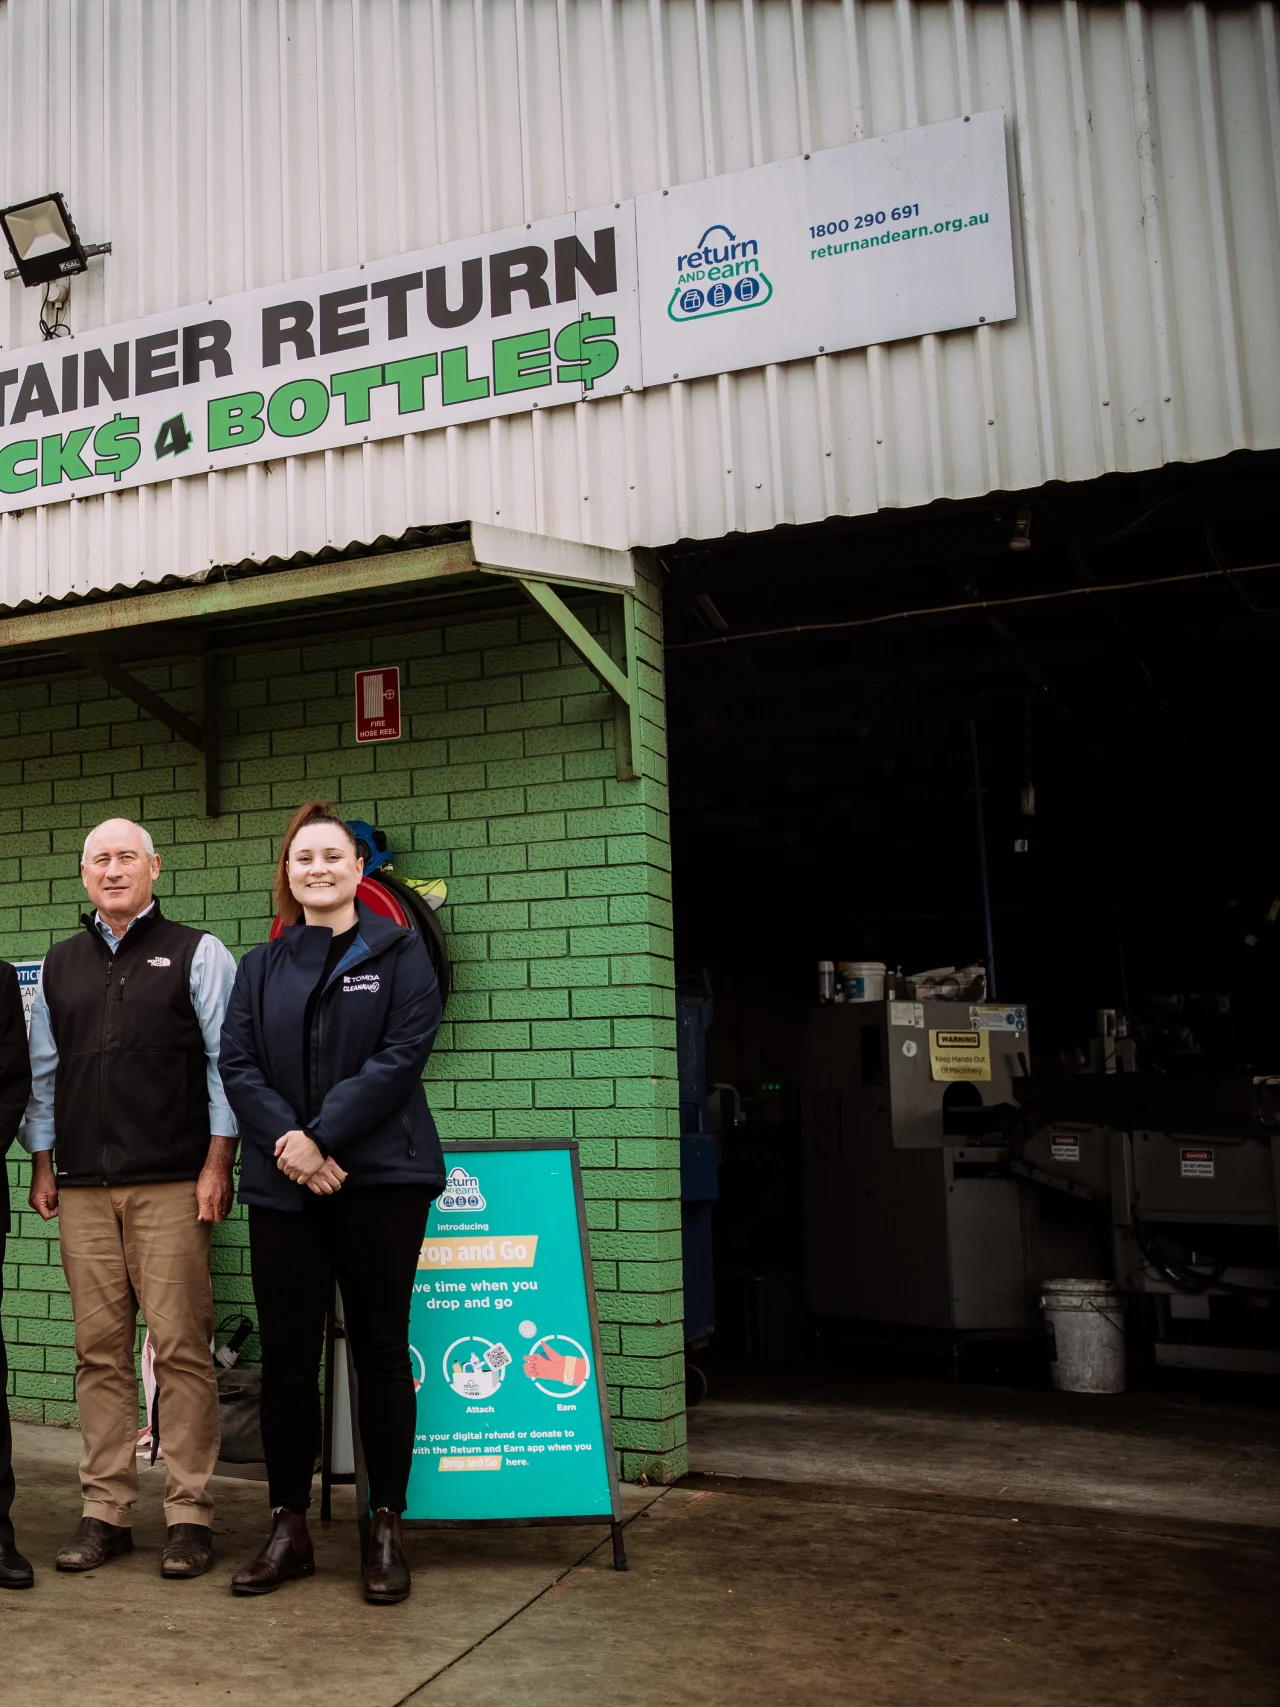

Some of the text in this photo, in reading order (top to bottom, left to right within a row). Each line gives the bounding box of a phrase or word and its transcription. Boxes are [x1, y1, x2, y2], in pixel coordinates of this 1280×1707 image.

[809, 203, 920, 239] 1800 290 691
[810, 211, 989, 260] returnandearn.org.au
[677, 237, 758, 271] return
[66, 258, 81, 270] SAL
[678, 257, 759, 285] AND earn
[261, 227, 618, 367] RETURN
[154, 411, 193, 461] 4
[208, 312, 619, 453] BOTTLE$
[370, 719, 386, 728] FIRE
[360, 727, 397, 738] HOSE REEL
[17, 970, 40, 981] OTICE
[941, 1036, 977, 1044] WARNING
[935, 1056, 951, 1064] Keep
[949, 1066, 983, 1076] Machinery
[446, 1177, 477, 1187] eturn
[455, 1186, 478, 1195] earn
[437, 1222, 489, 1231] Introducing
[420, 1240, 528, 1265] rop and Go
[435, 1281, 466, 1292] time
[470, 1280, 508, 1292] when
[512, 1281, 538, 1294] you
[426, 1297, 513, 1310] drop and go
[466, 1406, 494, 1414] Attach
[429, 1434, 451, 1442] your
[452, 1431, 482, 1441] digital
[484, 1430, 515, 1439] refund
[530, 1430, 562, 1438] donate
[432, 1446, 448, 1454] the
[450, 1445, 481, 1454] Return
[483, 1445, 501, 1453] and
[527, 1445, 545, 1453] app
[547, 1443, 572, 1451] when
[574, 1443, 592, 1452] you
[443, 1457, 530, 1469] Drop and Go here.
